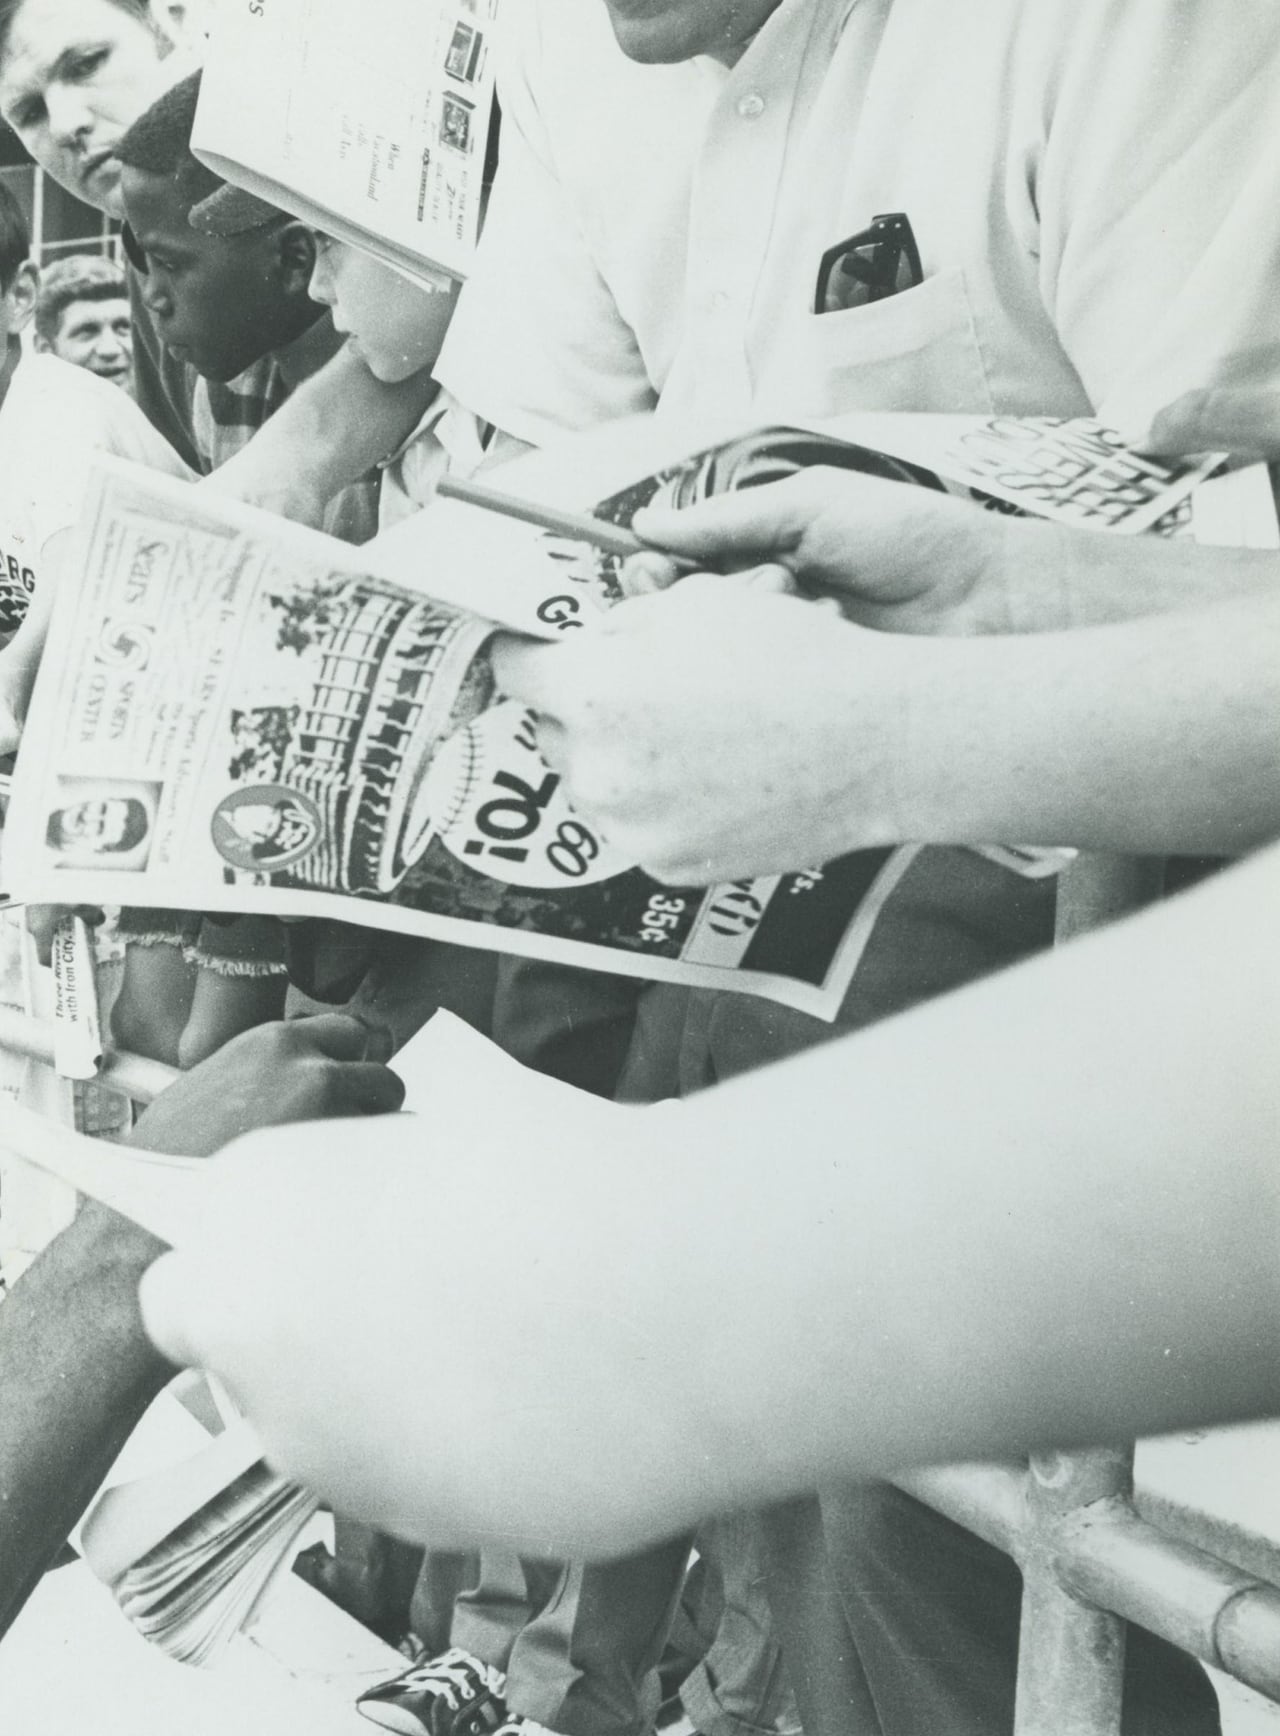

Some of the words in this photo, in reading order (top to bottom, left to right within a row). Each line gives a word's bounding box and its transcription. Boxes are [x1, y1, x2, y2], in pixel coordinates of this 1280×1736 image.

[121, 535, 170, 605] Sears
[79, 672, 106, 742] CENTER
[107, 679, 136, 742] SPORTS
[637, 895, 684, 945] 35¢
[63, 935, 75, 962] City.
[55, 982, 63, 1018] Three
[66, 967, 75, 992] Iron
[67, 995, 77, 1022] with
